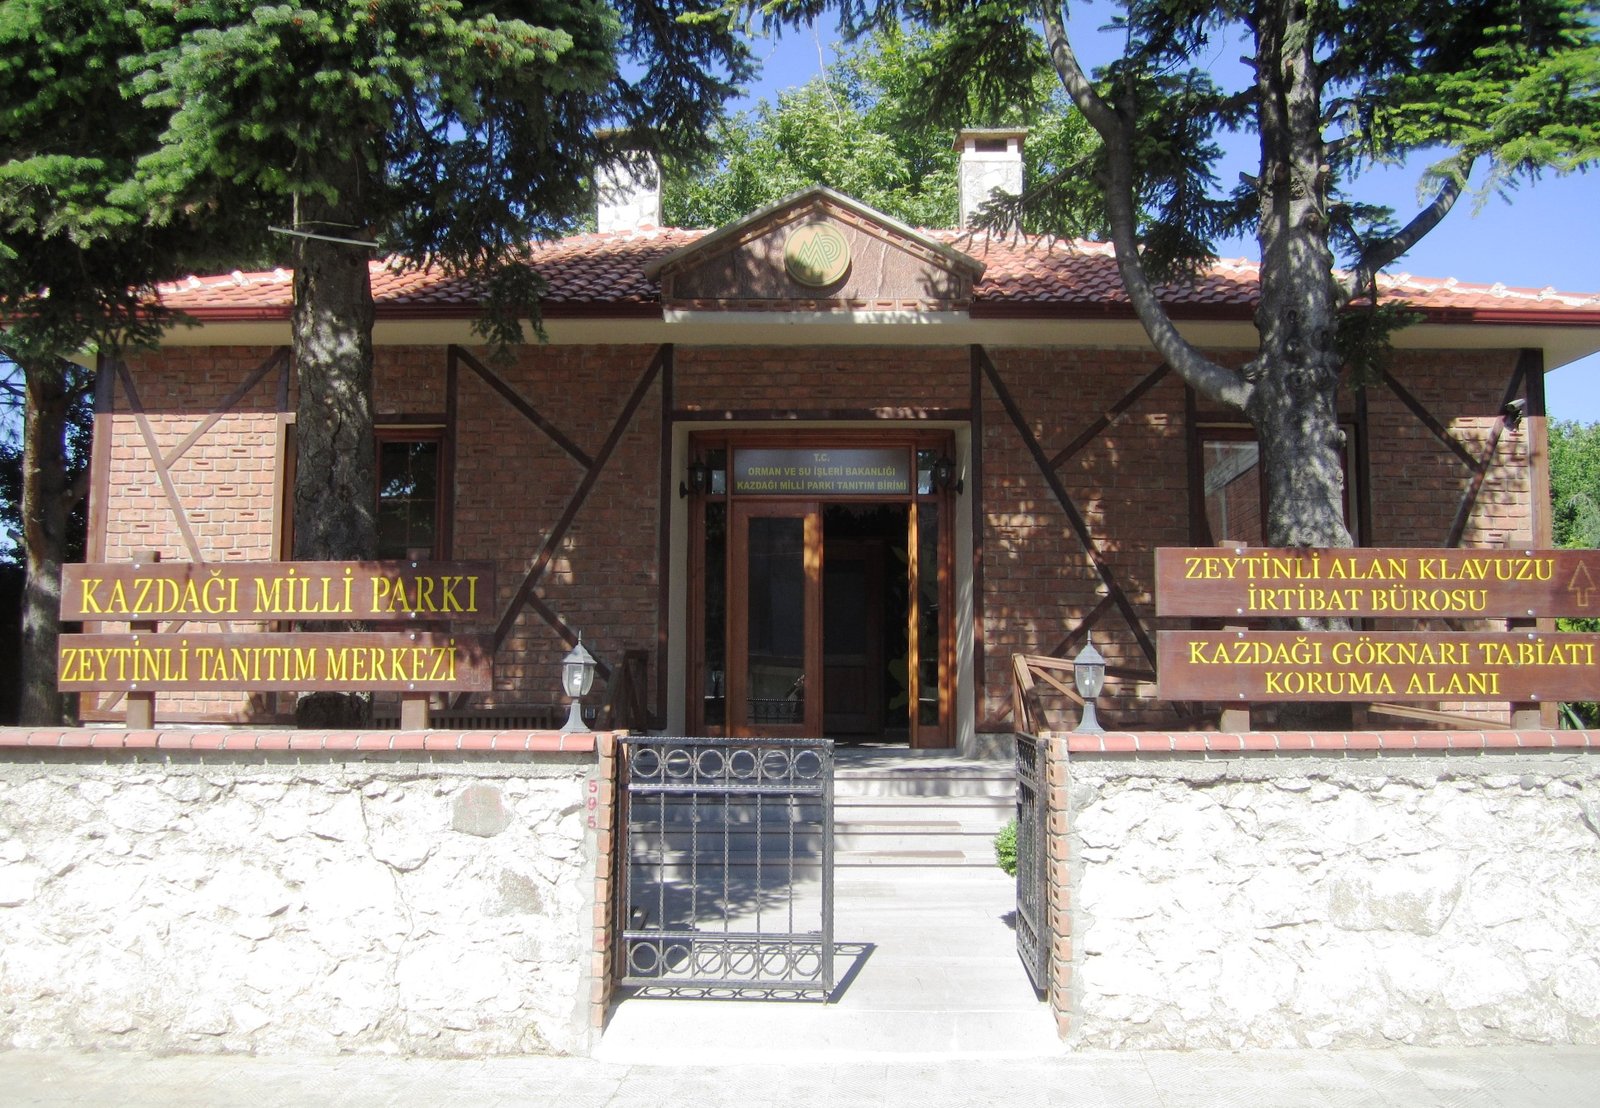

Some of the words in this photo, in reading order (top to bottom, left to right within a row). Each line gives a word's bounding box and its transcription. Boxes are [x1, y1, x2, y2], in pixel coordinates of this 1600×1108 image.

[748, 467, 781, 476] ORMAN
[784, 467, 796, 476] VE
[799, 467, 811, 476] SU
[813, 465, 843, 477] İŞLERİ
[845, 465, 896, 476] BAKANLIĞI
[813, 453, 830, 462] T.C.
[737, 480, 777, 490] KAZDAĞI
[780, 480, 804, 490] MİLLİ
[807, 481, 834, 490] PARKI
[837, 481, 874, 490] TANITIM
[877, 479, 907, 490] BİRİMİ
[1185, 552, 1320, 579] ZEYTİNLİ
[1327, 558, 1408, 580] ALAN
[1418, 558, 1554, 580] KLAVUZU
[79, 569, 239, 614] KAZDAĞI
[253, 567, 354, 613] MİLLİ
[370, 576, 479, 613] PARKI
[1248, 583, 1364, 611] İRTİBAT
[1371, 584, 1488, 611] BÜROSU
[60, 639, 189, 682] ZEYTİNLİ
[195, 647, 317, 681] TANITIM
[324, 638, 456, 681] MERKEZİ
[1188, 636, 1323, 665] KAZDAĞI
[1332, 637, 1470, 665] GÖKNARI
[1479, 638, 1596, 666] TABİATI
[1265, 672, 1396, 695] KORUMA
[1405, 672, 1500, 695] ALANI
[587, 779, 598, 829] 595
